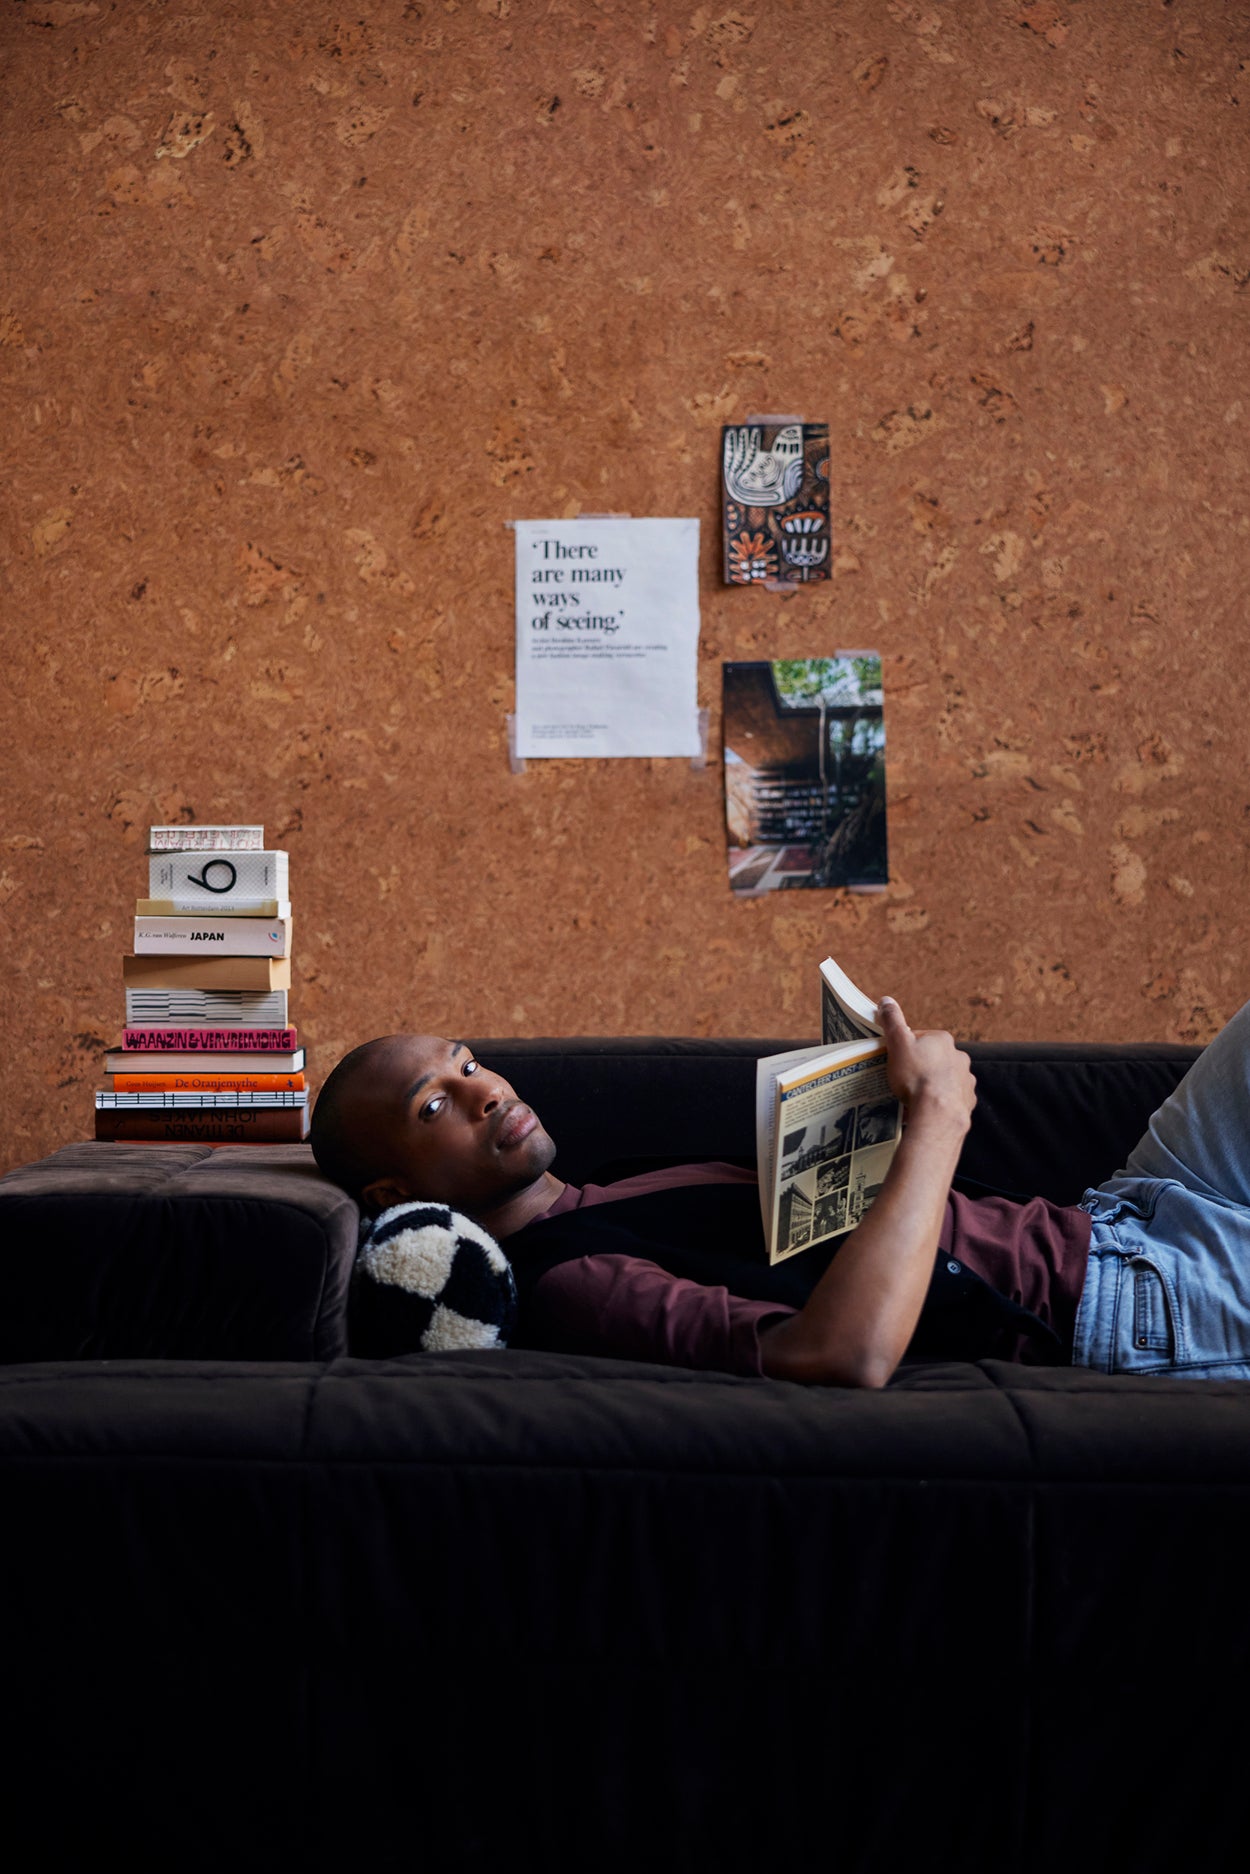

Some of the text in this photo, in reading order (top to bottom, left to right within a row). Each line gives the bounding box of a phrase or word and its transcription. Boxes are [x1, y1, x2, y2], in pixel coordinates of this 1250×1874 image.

[532, 568, 626, 588] are many
[532, 592, 580, 612] ways
[531, 611, 553, 631] of
[190, 932, 225, 941] JAPAN
[175, 1079, 190, 1088] De
[191, 1078, 258, 1092] Oranjemythe
[210, 1111, 258, 1123] JOHN
[227, 1125, 245, 1136] DE
